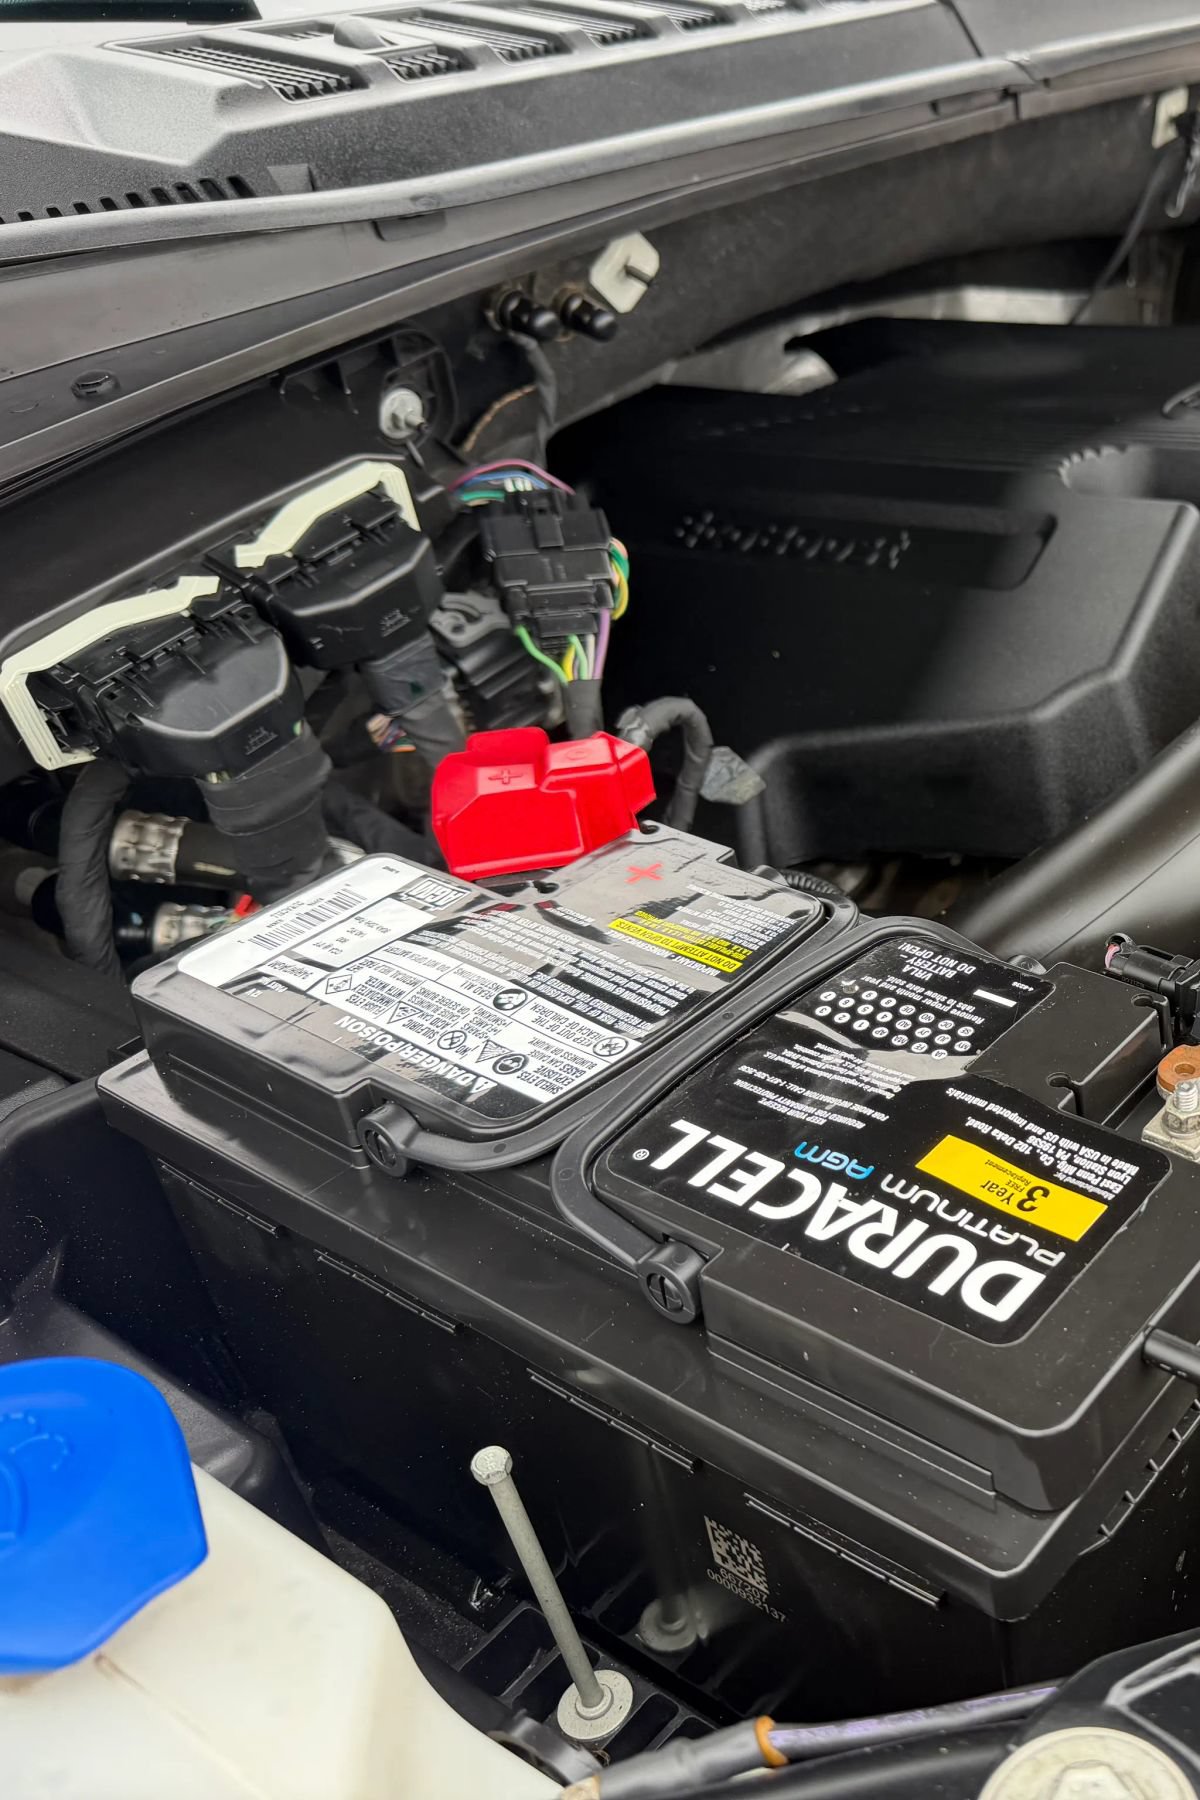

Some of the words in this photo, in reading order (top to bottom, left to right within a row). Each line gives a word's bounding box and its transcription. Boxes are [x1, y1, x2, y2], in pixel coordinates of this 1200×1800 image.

[406, 880, 465, 906] AGM
[616, 922, 642, 932] VENTS.
[640, 931, 662, 941] OPEN
[660, 938, 673, 946] TO
[671, 942, 707, 958] ATTEMPT
[898, 943, 932, 958] OPEN!
[672, 956, 719, 976] IMPORTANT
[704, 955, 724, 964] NOT
[722, 961, 736, 969] DO
[931, 955, 957, 967] NOT
[374, 964, 395, 975] HELP
[902, 965, 932, 980] VRLA
[906, 957, 956, 977] BATTERY
[956, 963, 976, 974] DO
[365, 976, 390, 991] WATER.
[390, 970, 422, 987] MEDICAL
[454, 968, 505, 992] INSTRUCTIONS
[460, 981, 477, 990] ALL
[861, 976, 881, 985] year
[886, 975, 904, 986] sold.
[385, 986, 406, 998] WITH
[473, 986, 495, 999] READ
[879, 982, 896, 990] and
[905, 982, 923, 993] date
[345, 994, 366, 1006] EYES
[349, 984, 394, 1006] IMMEDIATELY
[896, 988, 922, 1001] month
[924, 990, 946, 1001] show
[361, 1001, 385, 1015] FLUSH
[408, 995, 442, 1013] BLINDNESS
[435, 996, 461, 1010] SEVERE
[922, 998, 951, 1012] proper
[956, 1002, 975, 1012] tabs
[418, 1011, 434, 1022] CAN
[437, 1009, 460, 1022] CAUSE
[457, 1006, 470, 1015] OR
[531, 1003, 569, 1024] CHILDREN.
[950, 1009, 984, 1024] Remove
[430, 1017, 451, 1030] ACID
[531, 1016, 549, 1027] THE
[402, 1019, 439, 1039] SULFURIC
[556, 1028, 576, 1039] OUT
[576, 1026, 603, 1040] REACH
[528, 1037, 553, 1051] INJURY.
[573, 1037, 592, 1047] KEEP
[336, 1016, 474, 1084] DANGER/POISON
[455, 1045, 471, 1055] NO
[527, 1049, 551, 1062] CAUSE
[547, 1058, 564, 1068] CAN
[560, 1052, 597, 1070] BLINDNESS
[534, 1066, 574, 1086] EXPLOSIVE
[559, 1064, 586, 1078] GASES
[535, 1079, 563, 1094] SHIELD
[786, 1083, 805, 1093] CALL:
[805, 1090, 852, 1108] INFORMATION
[946, 1088, 987, 1107] materials
[776, 1097, 816, 1113] WARRANTY
[849, 1103, 874, 1115] MORE
[787, 1109, 808, 1119] YOUR
[806, 1116, 826, 1125] KEEP
[814, 1109, 831, 1118] FOR
[871, 1111, 889, 1121] FOR
[985, 1103, 1027, 1127] imported
[829, 1114, 865, 1129] REQUIRED
[965, 1117, 991, 1133] Road,
[1025, 1123, 1045, 1135] and
[991, 1129, 1015, 1145] Deka
[1043, 1132, 1059, 1143] US
[1013, 1141, 1032, 1154] 102
[1027, 1136, 1056, 1153] 19536
[1059, 1138, 1080, 1151] with
[795, 1142, 873, 1178] AGM
[1036, 1149, 1054, 1166] Co.,
[1056, 1149, 1071, 1160] PA
[1079, 1146, 1100, 1160] USA
[1100, 1155, 1112, 1164] in
[1057, 1160, 1077, 1175] Mfg.
[1074, 1155, 1107, 1175] Station,
[1111, 1159, 1139, 1176] Made
[985, 1160, 1030, 1186] Replacement
[1076, 1169, 1101, 1185] Penn
[1107, 1169, 1131, 1185] Lyon
[981, 1181, 1014, 1204] Year
[1006, 1180, 1025, 1192] FREE
[1066, 1177, 1114, 1200] Manufactured
[1100, 1179, 1123, 1194] East
[1017, 1186, 1050, 1212] 3
[882, 1175, 1064, 1265] PLATINUM
[720, 1568, 768, 1602] 667207
[706, 1568, 786, 1622] 0000932137
